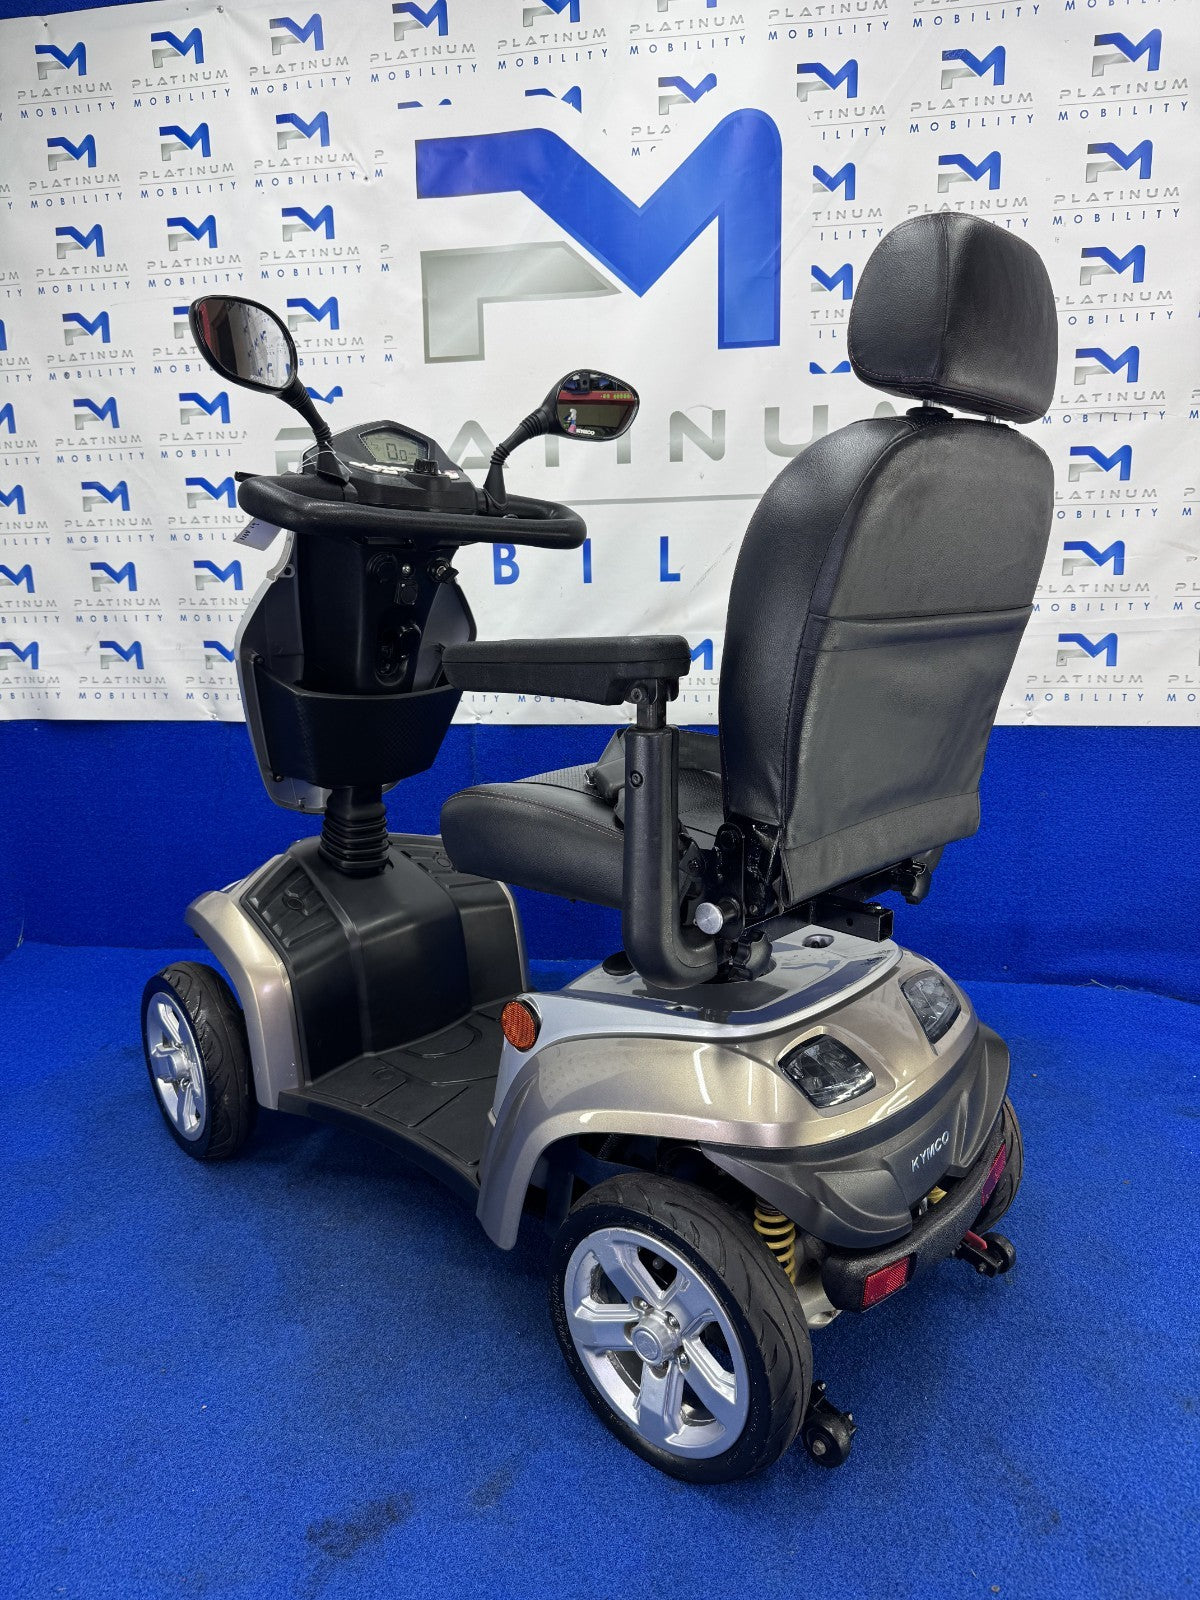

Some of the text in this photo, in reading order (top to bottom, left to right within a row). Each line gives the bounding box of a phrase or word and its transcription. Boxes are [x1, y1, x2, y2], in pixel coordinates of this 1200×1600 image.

[768, 0, 888, 20] PLATINUM
[912, 4, 1040, 28] MOBILITY
[629, 14, 745, 34] PLATINUM
[768, 20, 889, 41] MOBILITY
[497, 27, 607, 50] PLATINUM
[629, 35, 746, 55] MOBILITY
[370, 43, 475, 63] PLATINUM
[497, 48, 608, 70] MOBILITY
[249, 56, 349, 77] PLATINUM
[370, 63, 477, 83] MOBILITY
[131, 69, 228, 89] PLATINUM
[250, 76, 351, 96] MOBILITY
[17, 82, 112, 99] PLATINUM
[1059, 78, 1188, 99] PLATINUM
[133, 88, 231, 108] MOBILITY
[910, 92, 1033, 112] PLATINUM
[20, 101, 116, 119] MOBILITY
[1058, 101, 1188, 121] MOBILITY
[909, 114, 1034, 134] MOBILITY
[254, 152, 355, 169] PLATINUM
[139, 162, 234, 180] PLATINUM
[29, 173, 120, 191] PLATINUM
[255, 171, 357, 188] MOBILITY
[140, 181, 236, 199] MOBILITY
[1053, 186, 1180, 204] PLATINUM
[30, 192, 123, 209] MOBILITY
[907, 196, 1028, 214] PLATINUM
[1052, 208, 1180, 226] MOBILITY
[259, 246, 360, 260] PLATINUM
[147, 254, 241, 270] PLATINUM
[36, 263, 128, 277] PLATINUM
[261, 264, 362, 279] MOBILITY
[148, 272, 244, 288] MOBILITY
[37, 281, 130, 295] MOBILITY
[1068, 310, 1173, 326] OBILITY
[47, 349, 134, 364] PLATINUM
[153, 346, 199, 357] PLAT
[299, 355, 366, 367] BILITY
[49, 366, 136, 381] MOBILITY
[154, 363, 203, 375] MOBI
[1060, 391, 1166, 404] LATINUM
[1042, 410, 1166, 424] MOBILITY
[55, 434, 142, 447] PLATINUM
[4, 456, 40, 466] LITY
[56, 451, 145, 464] MOBILITY
[160, 448, 231, 459] MOBILI
[1055, 489, 1158, 499] LATINUM
[168, 515, 244, 525] PLATINU
[1057, 508, 1158, 519] OBILITY
[64, 517, 152, 528] PLATINUM
[3, 537, 51, 546] ILITY
[66, 534, 155, 544] MOBILITY
[170, 533, 232, 542] MOBIL
[0, 599, 58, 608] TINUM
[74, 598, 160, 607] PLATINUM
[178, 597, 249, 606] PLATINU
[1, 615, 60, 624] BILITY
[75, 614, 163, 623] MOBILITY
[180, 613, 236, 623] MOBIL
[1, 676, 59, 685] ATINUM
[79, 676, 166, 684] PLATINUM
[186, 676, 234, 685] PLATI
[1026, 674, 1143, 683] PLATINUM
[0, 691, 61, 700] BILITY
[78, 691, 169, 700] MOBILITY
[186, 692, 242, 700] MOBIL
[1024, 693, 1144, 702] MOBILITY
[910, 1130, 950, 1173] KYMCO
